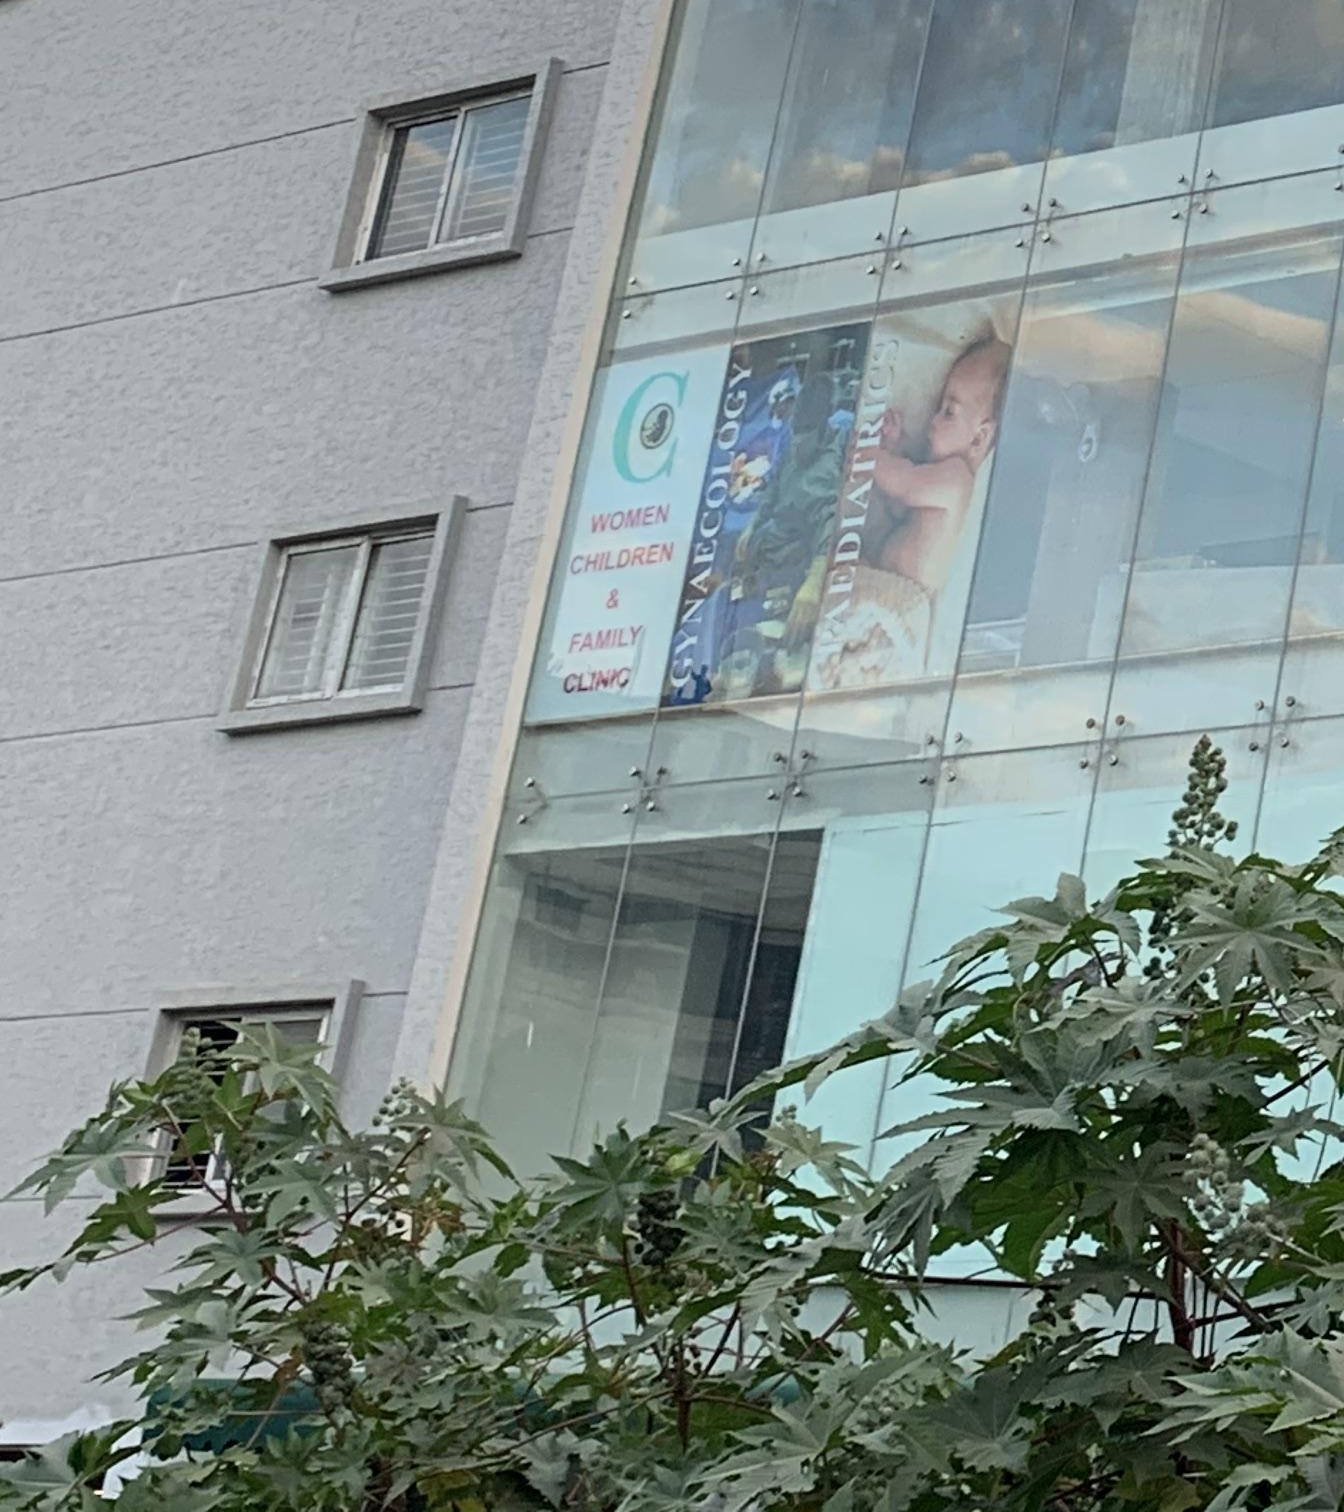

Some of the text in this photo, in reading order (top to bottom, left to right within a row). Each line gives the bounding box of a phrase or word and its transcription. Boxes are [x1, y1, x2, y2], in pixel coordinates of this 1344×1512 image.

[590, 504, 670, 534] WOMEN
[670, 360, 754, 689] GYNAECOLOGY
[570, 541, 675, 576] CHILDREN
[605, 587, 620, 610] &
[568, 624, 644, 654] FAMILY
